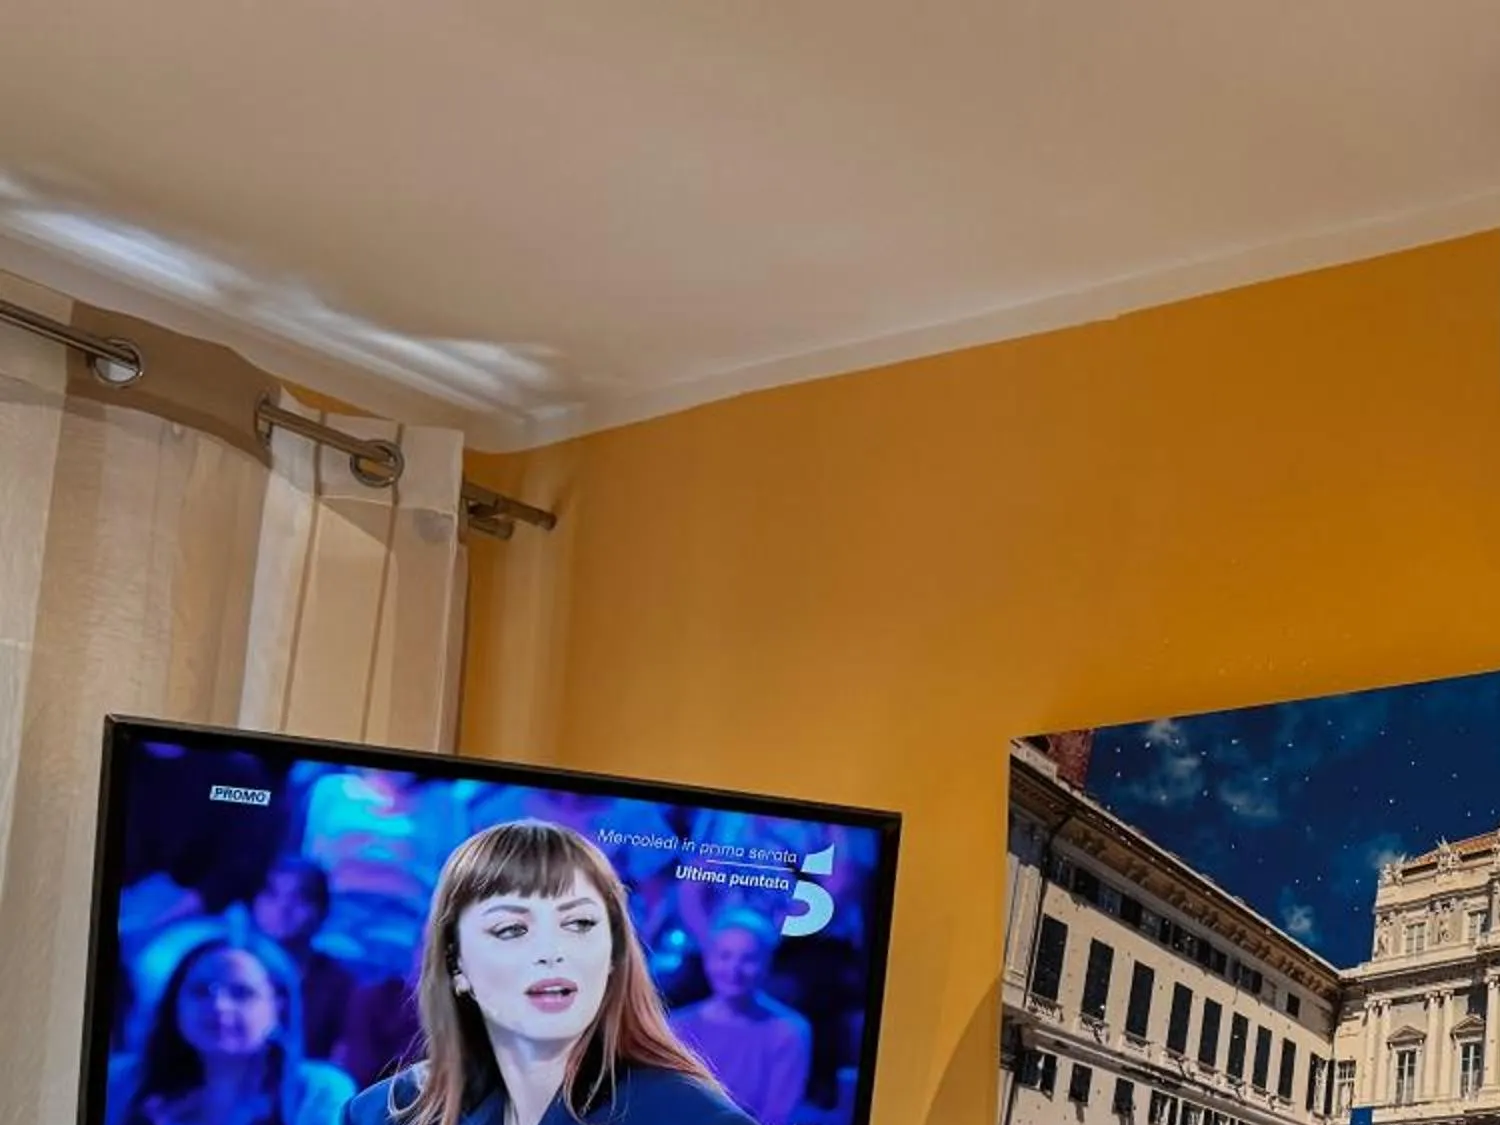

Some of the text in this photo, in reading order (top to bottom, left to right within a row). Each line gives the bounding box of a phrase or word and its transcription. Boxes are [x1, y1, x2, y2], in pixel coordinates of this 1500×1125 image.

[215, 787, 267, 803] PROMO
[597, 829, 678, 850] Mercoledì
[682, 837, 696, 853] in
[748, 848, 798, 865] serata
[675, 865, 789, 891] Ultima puntata
